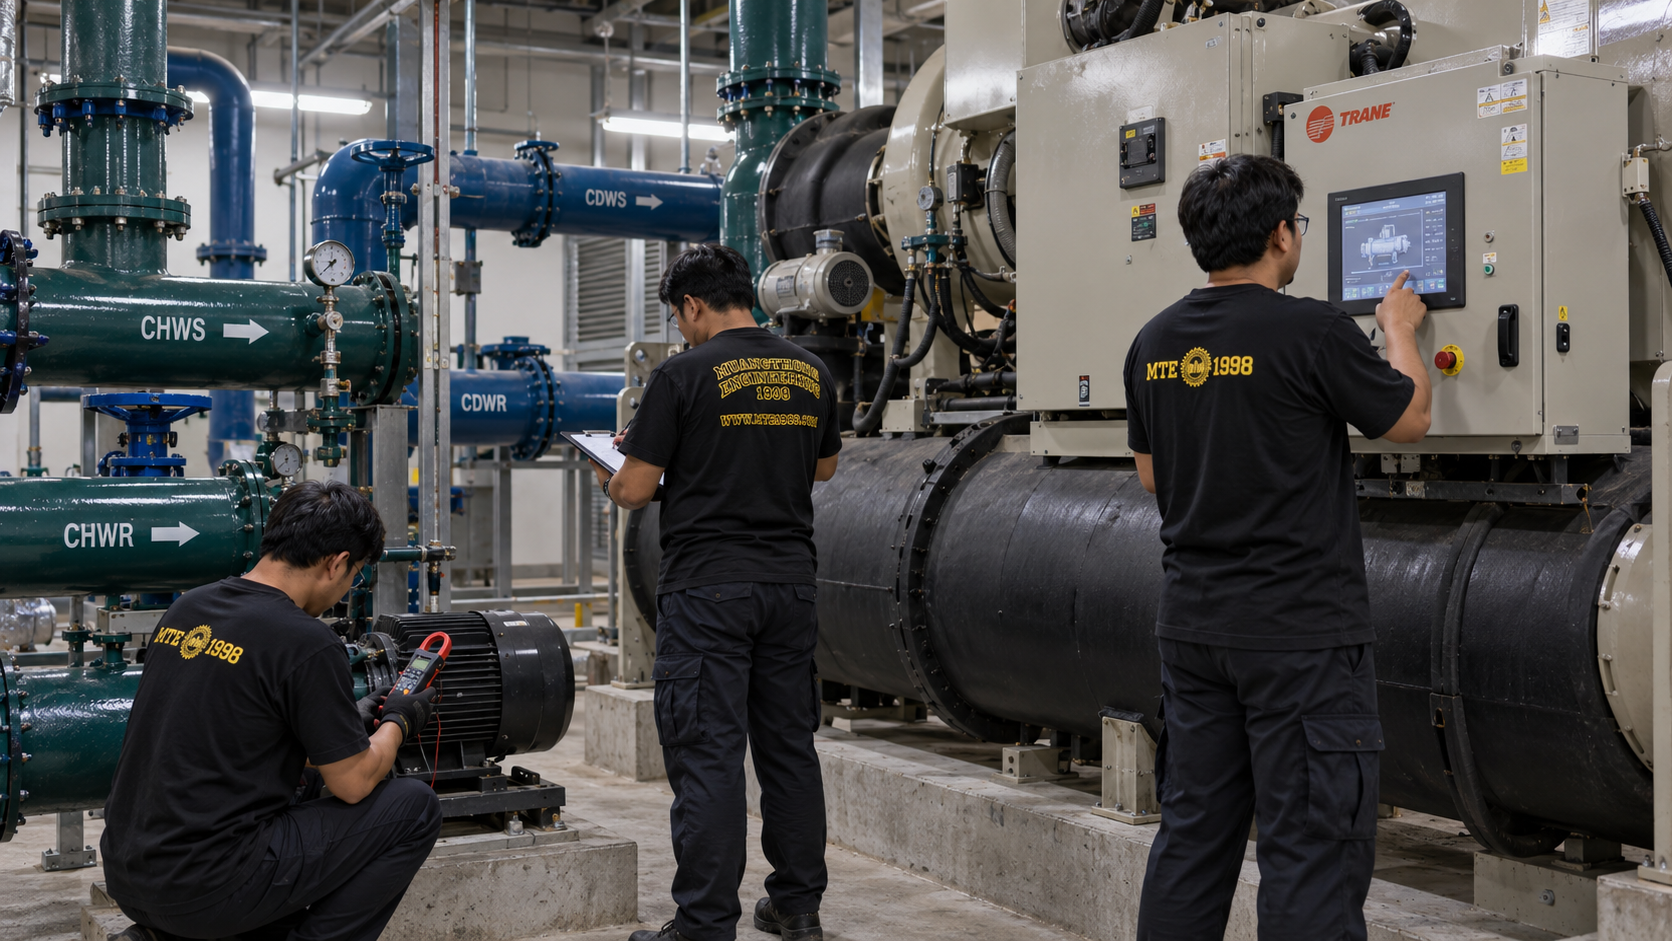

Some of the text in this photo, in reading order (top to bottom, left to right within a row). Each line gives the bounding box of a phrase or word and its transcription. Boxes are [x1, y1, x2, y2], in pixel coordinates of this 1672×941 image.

[1340, 102, 1393, 127] TRANE
[585, 188, 627, 209] CDWS
[141, 314, 206, 342] CHWS
[1146, 355, 1254, 381] MTE 1998
[461, 393, 507, 412] CDWR
[63, 521, 134, 549] CHWR
[204, 638, 244, 665] 1998
